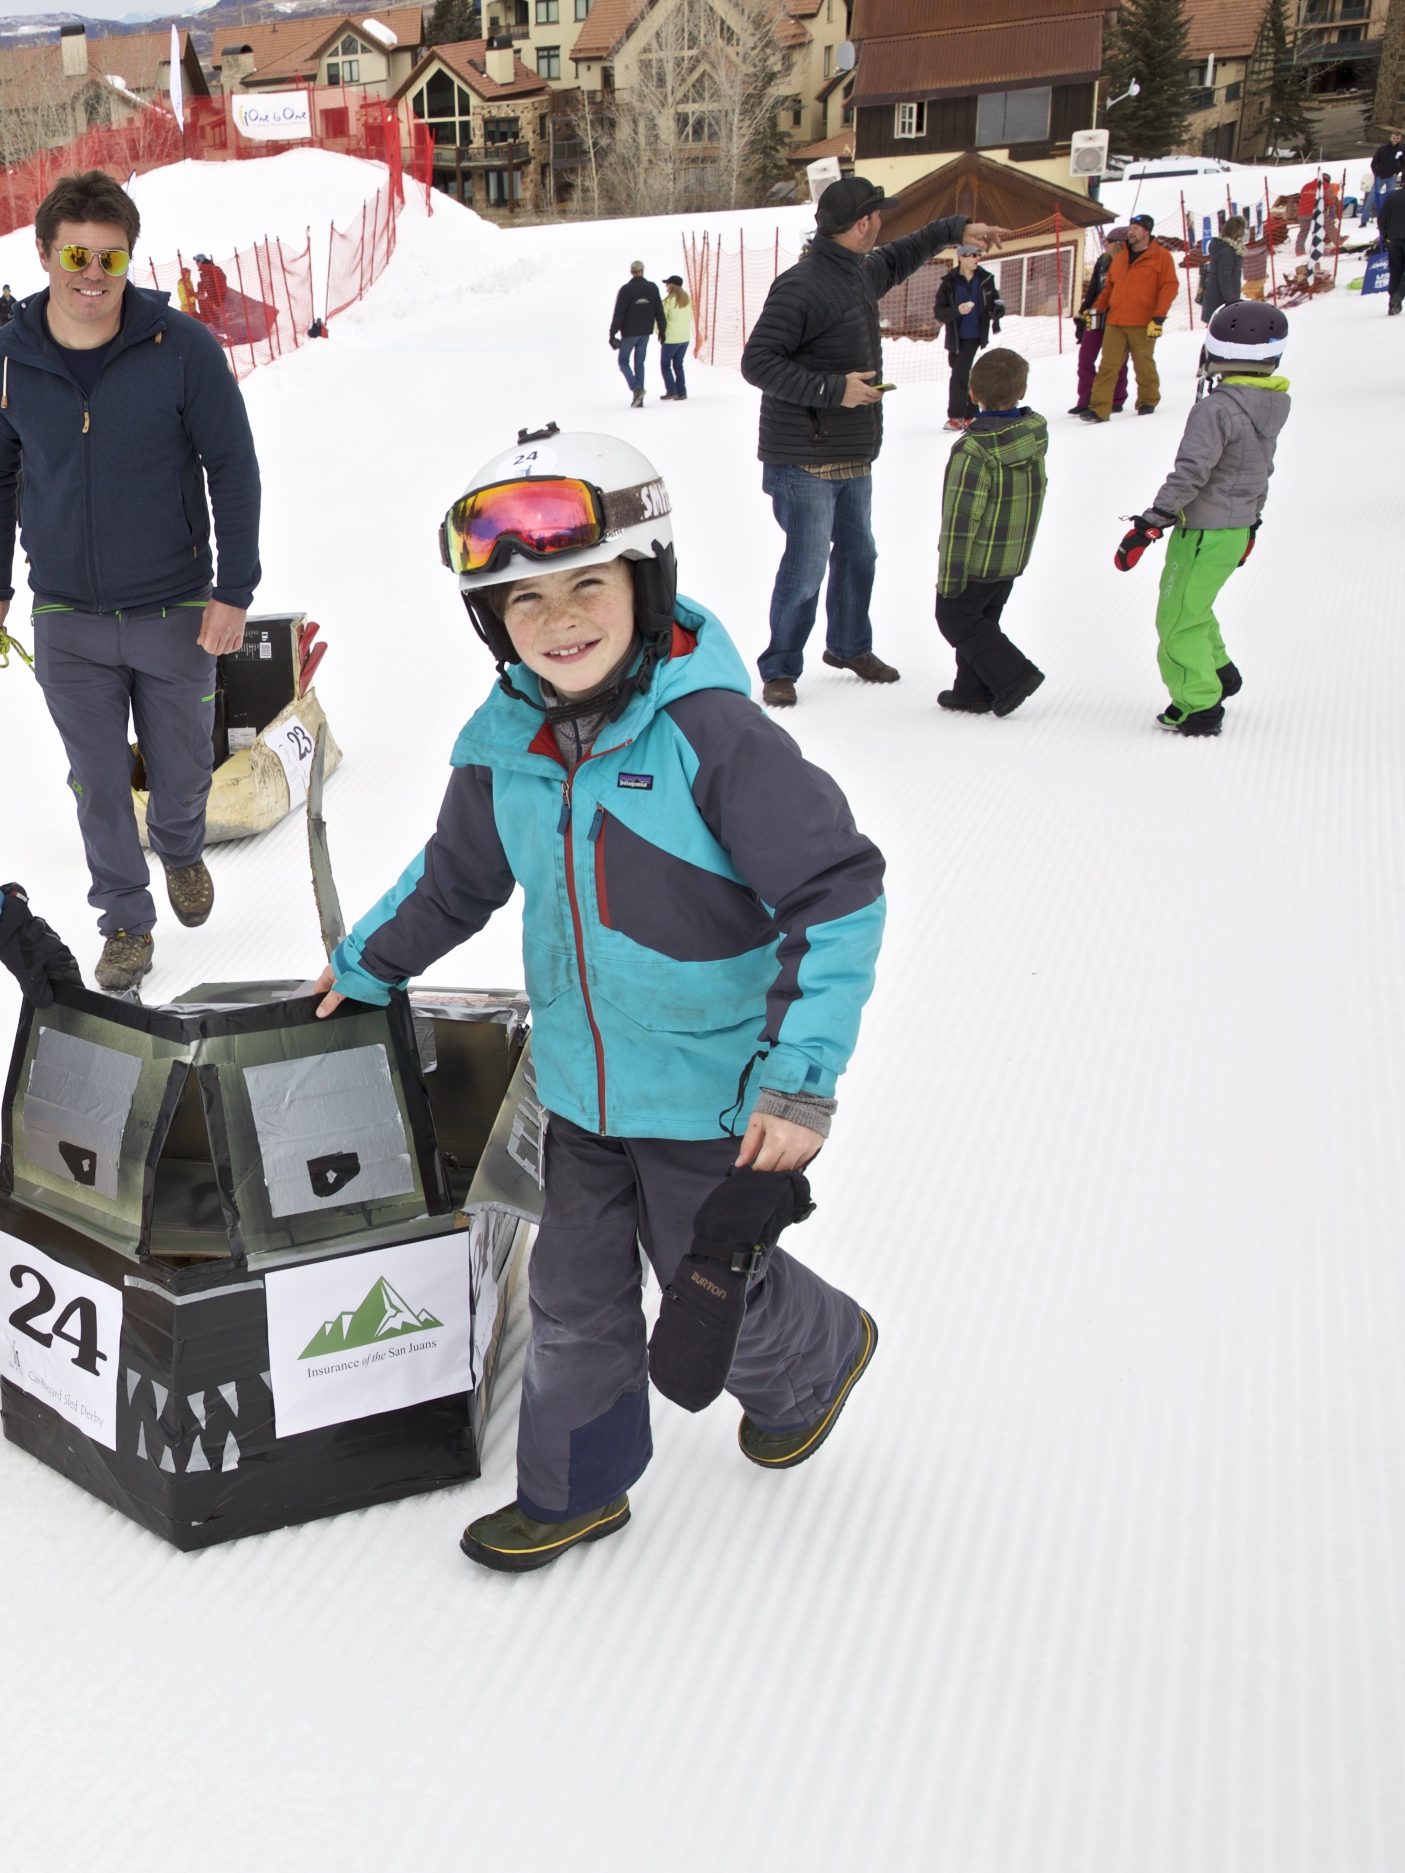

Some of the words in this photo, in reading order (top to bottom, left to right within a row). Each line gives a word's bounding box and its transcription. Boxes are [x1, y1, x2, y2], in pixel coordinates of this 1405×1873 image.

[249, 109, 269, 122] One
[283, 107, 307, 120] One
[513, 451, 538, 465] 24
[607, 530, 622, 540] MITH
[287, 726, 312, 761] 23
[619, 780, 647, 788] patagonia
[691, 1271, 727, 1300] BURTON
[9, 1264, 107, 1377] 24
[307, 1359, 359, 1378] Insurance
[361, 1354, 371, 1367] of
[371, 1352, 386, 1363] the
[388, 1347, 406, 1358] San
[408, 1340, 437, 1353] Juans
[28, 1370, 62, 1402] Cardboard
[64, 1394, 78, 1413] Sled
[80, 1404, 104, 1429] Derby
